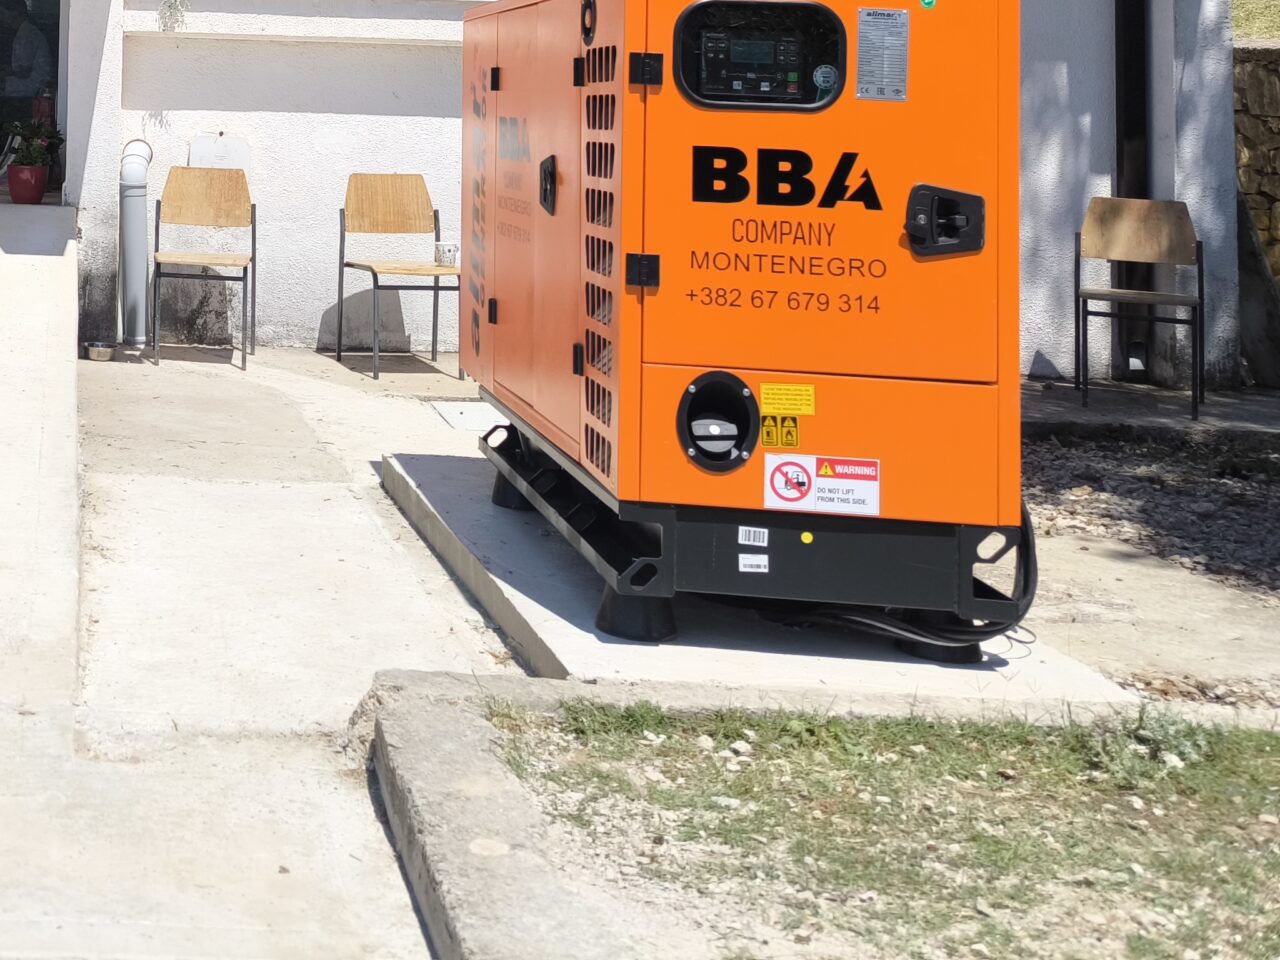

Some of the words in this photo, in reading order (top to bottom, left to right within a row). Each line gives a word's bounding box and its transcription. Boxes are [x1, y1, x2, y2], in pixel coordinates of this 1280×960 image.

[692, 145, 883, 211] BBA
[732, 218, 836, 247] COMPANY
[690, 250, 887, 278] MONTENEGRO
[685, 287, 742, 308] +382
[750, 290, 778, 309] 67
[787, 291, 830, 312] 679
[838, 294, 881, 314] 314
[834, 464, 877, 476] WARNING
[827, 487, 840, 495] NOT
[841, 488, 855, 496] LIFT
[852, 498, 869, 506] SIDE.
